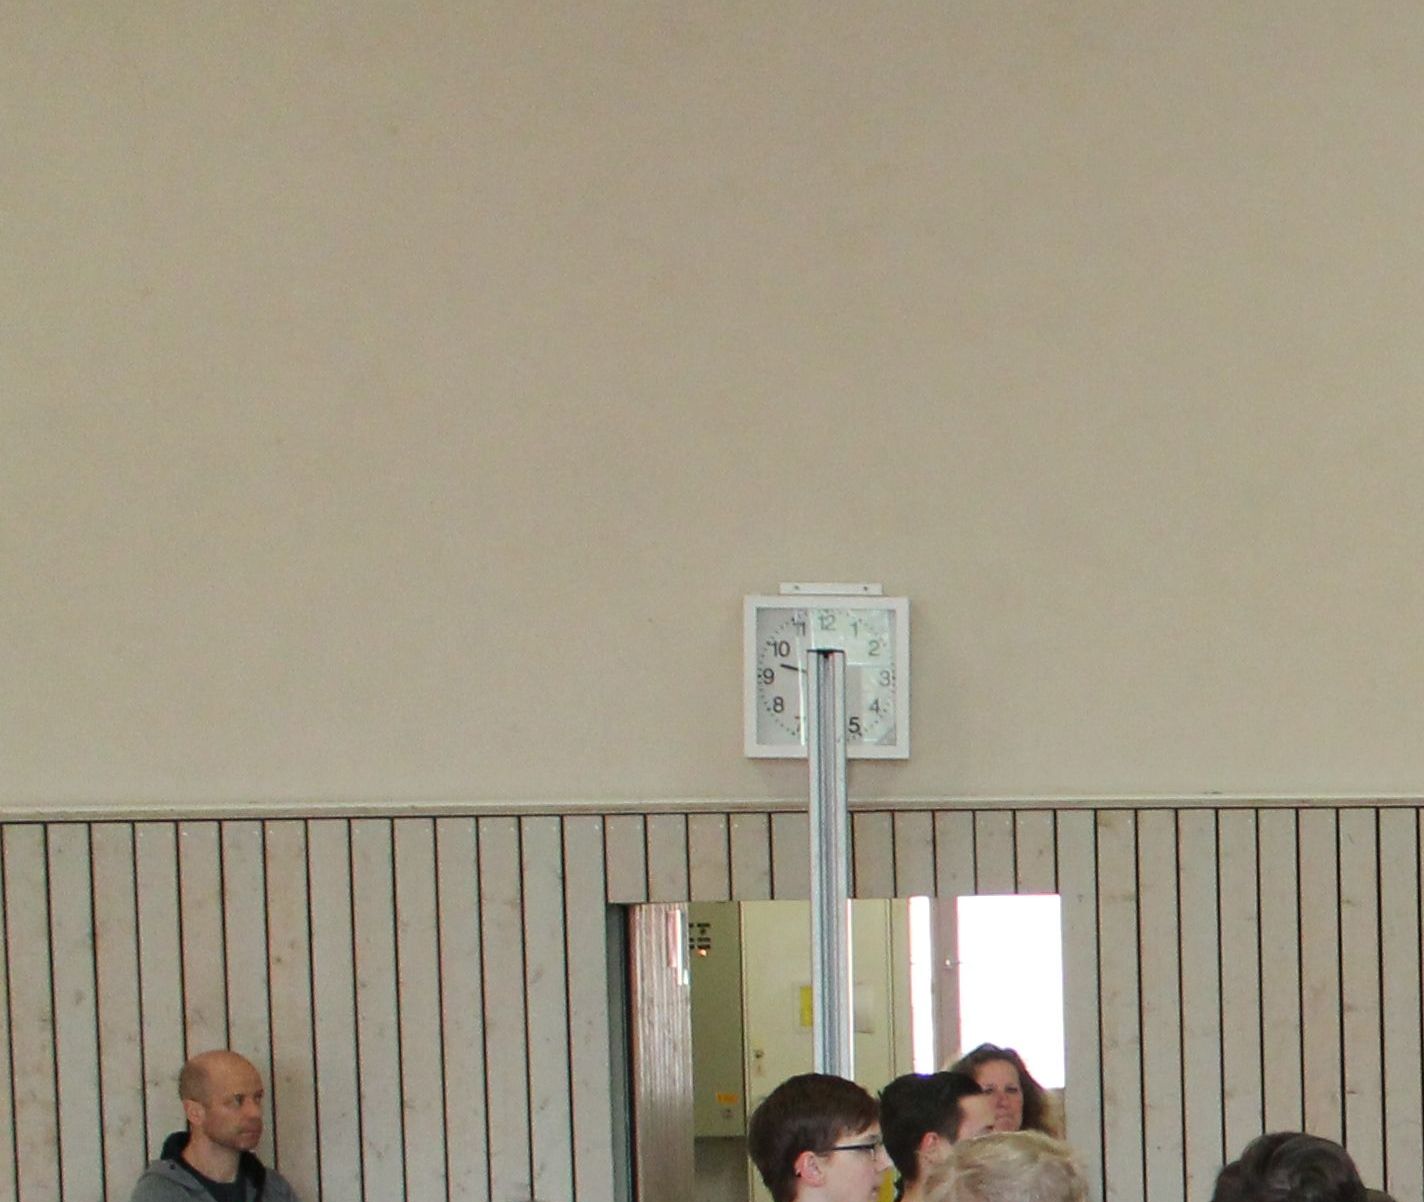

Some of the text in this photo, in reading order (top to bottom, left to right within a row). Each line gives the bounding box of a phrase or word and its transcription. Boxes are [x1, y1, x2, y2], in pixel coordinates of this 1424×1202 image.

[819, 615, 836, 631] 12
[849, 622, 858, 637] 1
[773, 640, 791, 657] 10
[868, 640, 880, 656] 2
[762, 668, 775, 685] 9
[879, 670, 890, 686] 3
[772, 696, 785, 713] 8
[869, 698, 880, 713] 4
[848, 716, 861, 734] 5
